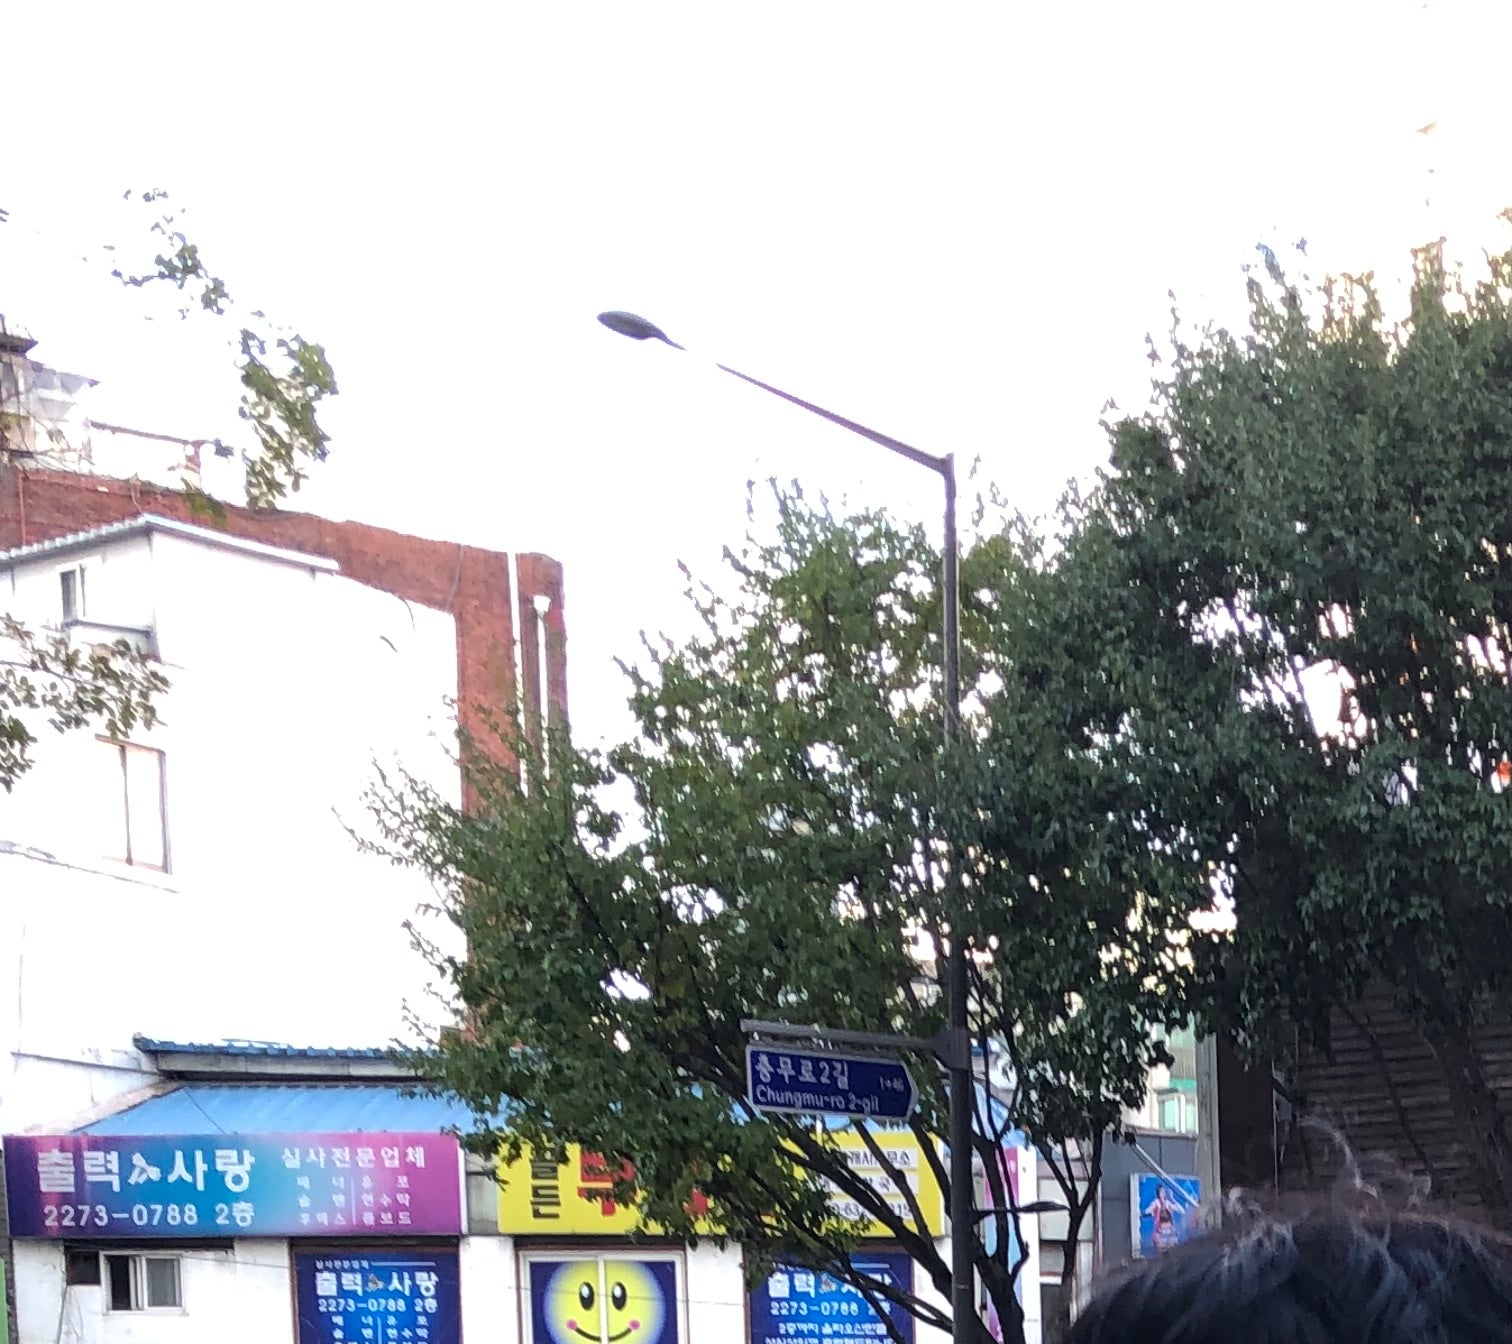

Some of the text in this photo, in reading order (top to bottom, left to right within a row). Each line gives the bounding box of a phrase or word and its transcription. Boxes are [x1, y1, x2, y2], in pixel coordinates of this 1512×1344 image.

[756, 1084, 845, 1109] Chungmu-ro
[282, 1146, 426, 1169] 실사전문업체
[37, 1149, 255, 1193] 출력 사랑
[43, 1201, 255, 1228] 2273-0788 2층
[315, 1271, 439, 1297] 출력 사랑
